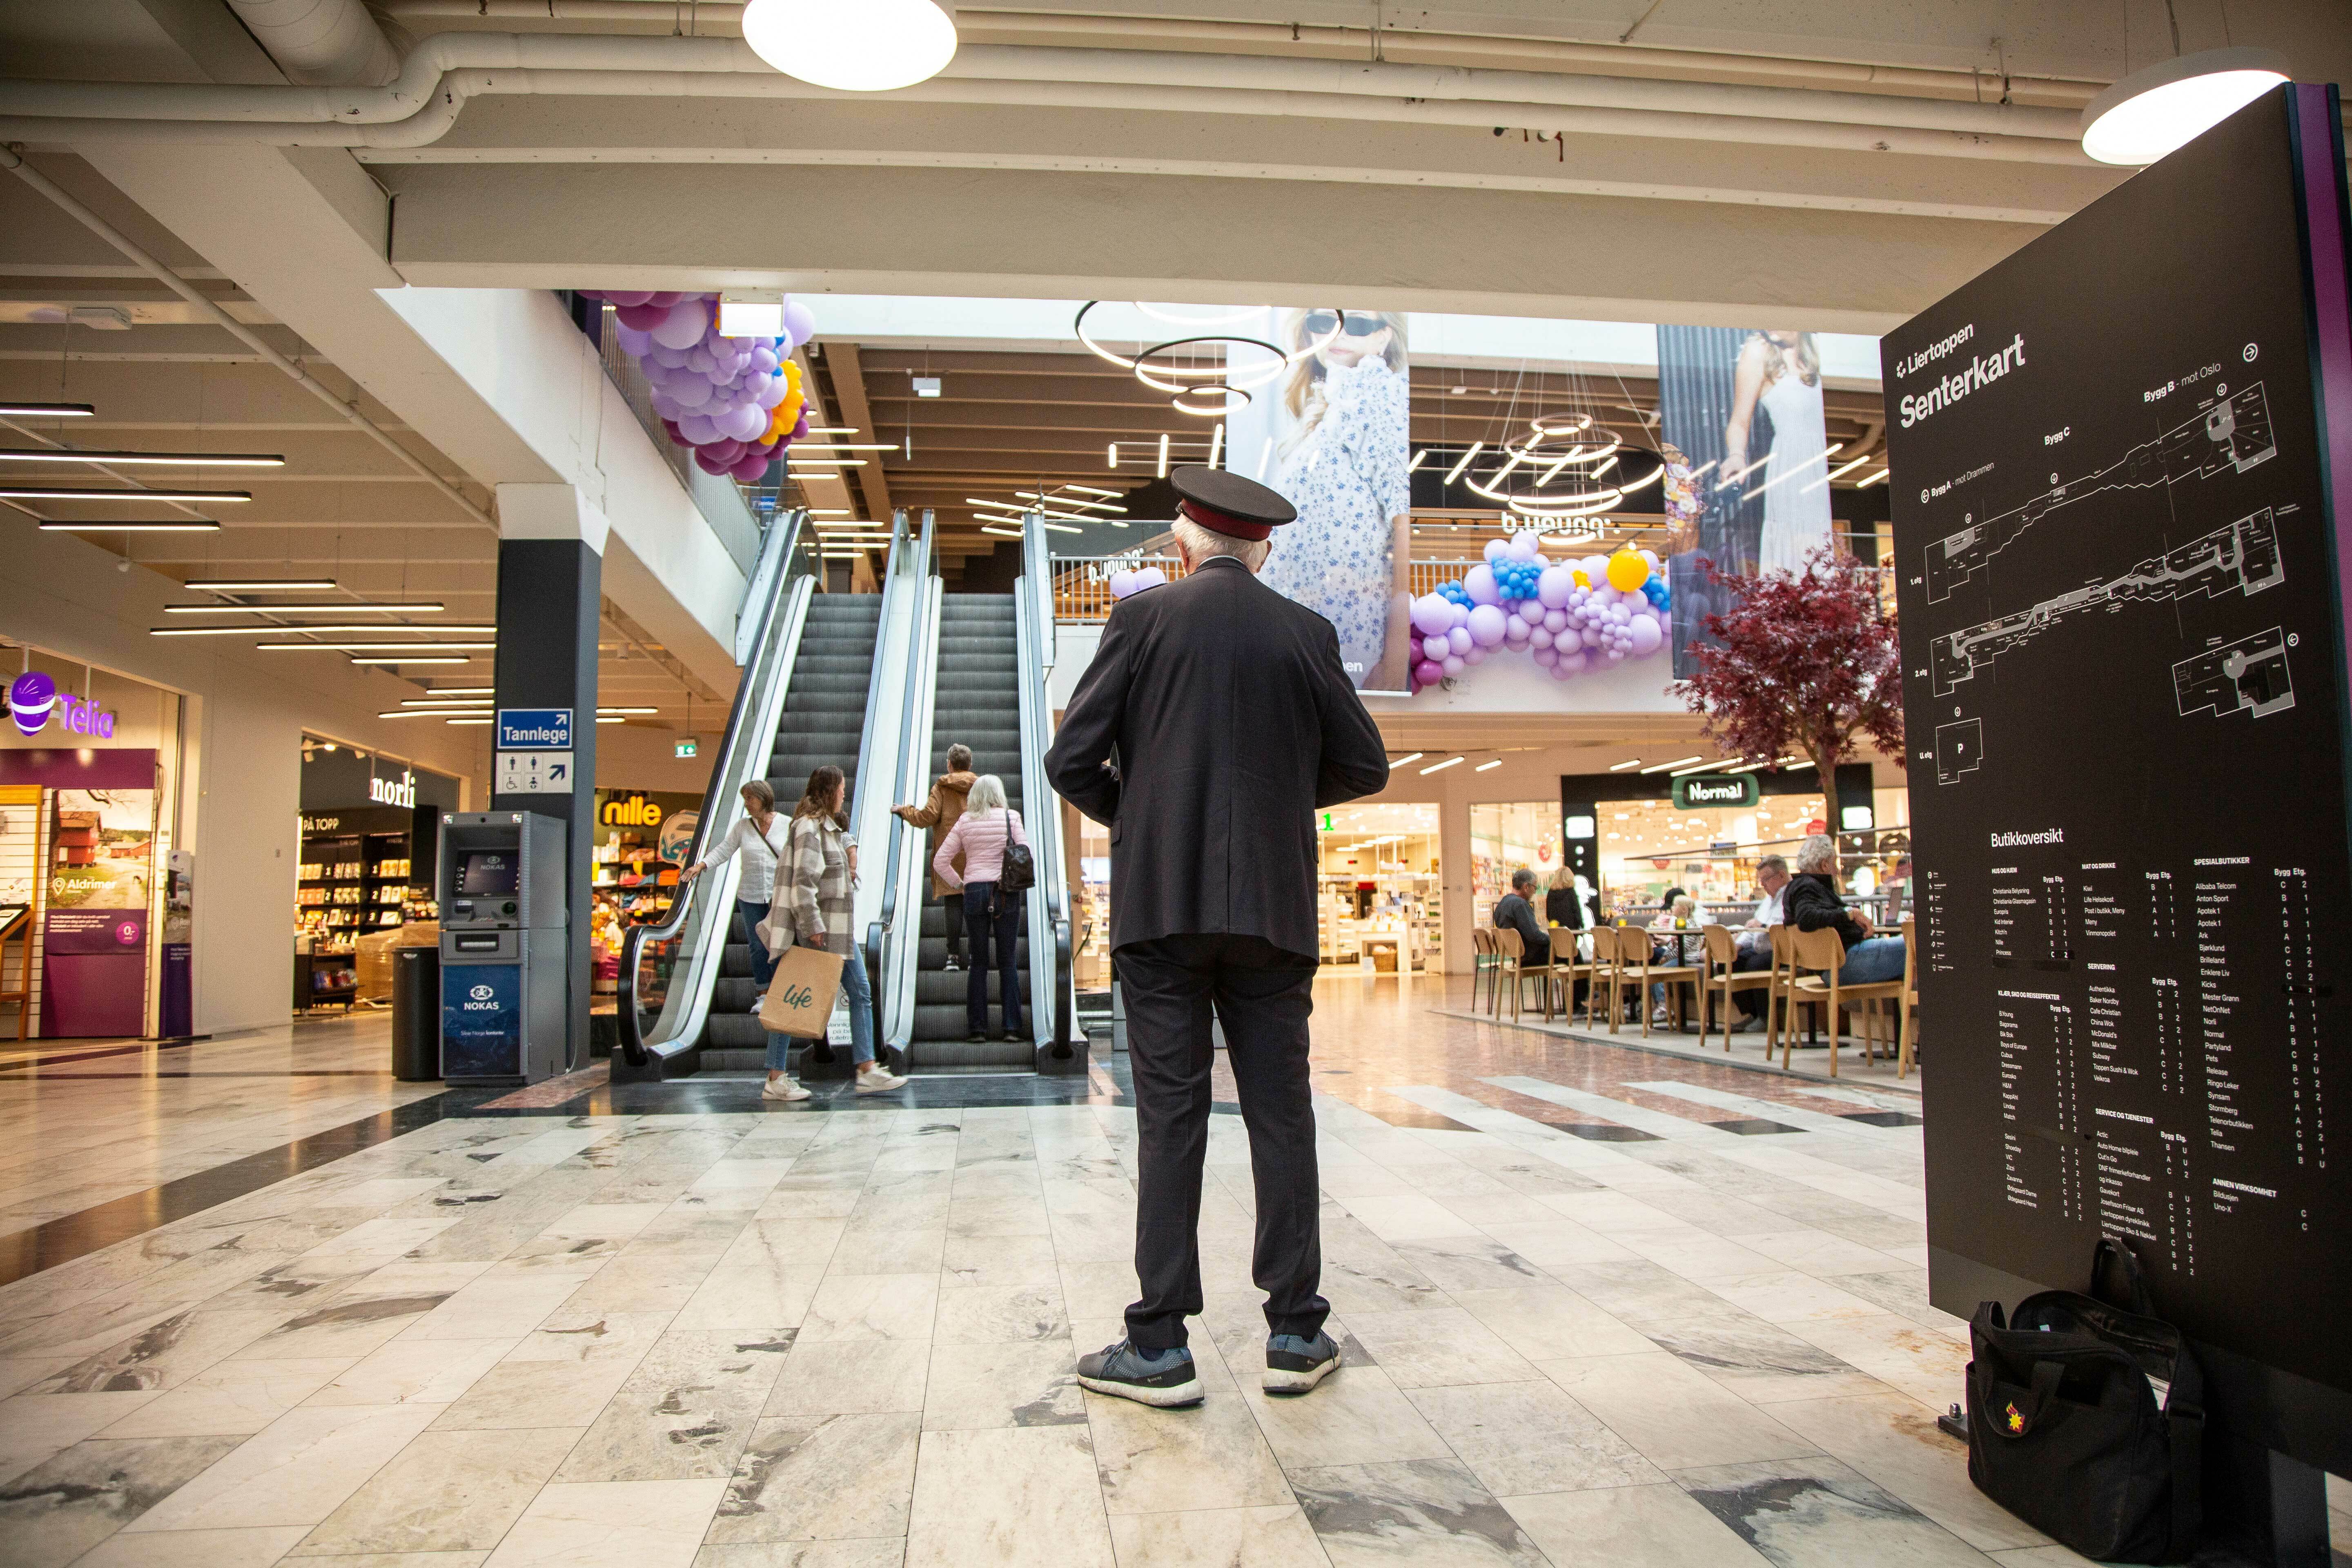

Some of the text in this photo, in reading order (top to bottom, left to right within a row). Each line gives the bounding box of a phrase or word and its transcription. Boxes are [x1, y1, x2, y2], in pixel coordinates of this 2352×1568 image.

[1908, 324, 1973, 374] Liertoppen
[1900, 333, 2025, 428] Senterkart
[2144, 387, 2166, 402] Bygg
[2167, 381, 2175, 392] B
[2182, 372, 2198, 386] mot
[2201, 363, 2221, 378] Oslo
[2045, 427, 2070, 445] Bygg C
[1931, 485, 1946, 497] Bygg
[1947, 481, 1951, 489] A
[1955, 475, 1966, 486] mot
[1967, 463, 1994, 480] Drammen
[60, 693, 113, 738] Telia
[503, 727, 567, 744] Tannlege
[1958, 744, 1963, 753] P
[371, 771, 416, 808] norli
[1689, 782, 1742, 801] Normal
[603, 796, 662, 826] nille
[303, 817, 339, 831] PÅ TOPP
[1323, 813, 1334, 830] 1
[1991, 828, 2063, 847] Butikkoversikt
[2194, 857, 2250, 865] SPESIALBUTIKKER
[67, 879, 117, 889] Aldrimer
[2152, 978, 2178, 987] Bygg Etg.
[783, 984, 813, 1009] life
[2103, 998, 2119, 1006] Nordby
[464, 1002, 499, 1010] NOKAS
[2203, 1005, 2230, 1014] NetOnNet
[2205, 1030, 2224, 1038] Normal
[2101, 1042, 2117, 1050] Milkbar
[2205, 1042, 2231, 1051] Partyland
[2092, 1052, 2110, 1061] Subway
[2002, 1062, 2022, 1070] Dressmann
[2207, 1067, 2228, 1076] Release
[2207, 1079, 2239, 1090] Ringo Leker
[2207, 1091, 2230, 1100] Synsam
[2208, 1104, 2238, 1115] Stormberg
[2096, 1108, 2116, 1117] SERVICE
[2125, 1113, 2153, 1124] TJENESTER
[2209, 1116, 2253, 1129] Telenorbutikken
[2160, 1131, 2187, 1143] Bygg Etg.
[2210, 1128, 2223, 1137] Telia
[2005, 1144, 2021, 1153] Shoeday
[2210, 1140, 2234, 1152] Thansen
[2007, 1174, 2022, 1183] Zavanna
[2100, 1187, 2119, 1197] Gavekort
[2213, 1178, 2277, 1197] ANNEN VIRKSOMHET
[2214, 1203, 2232, 1213] Uno-X
[2101, 1209, 2124, 1221] Liertoppen
